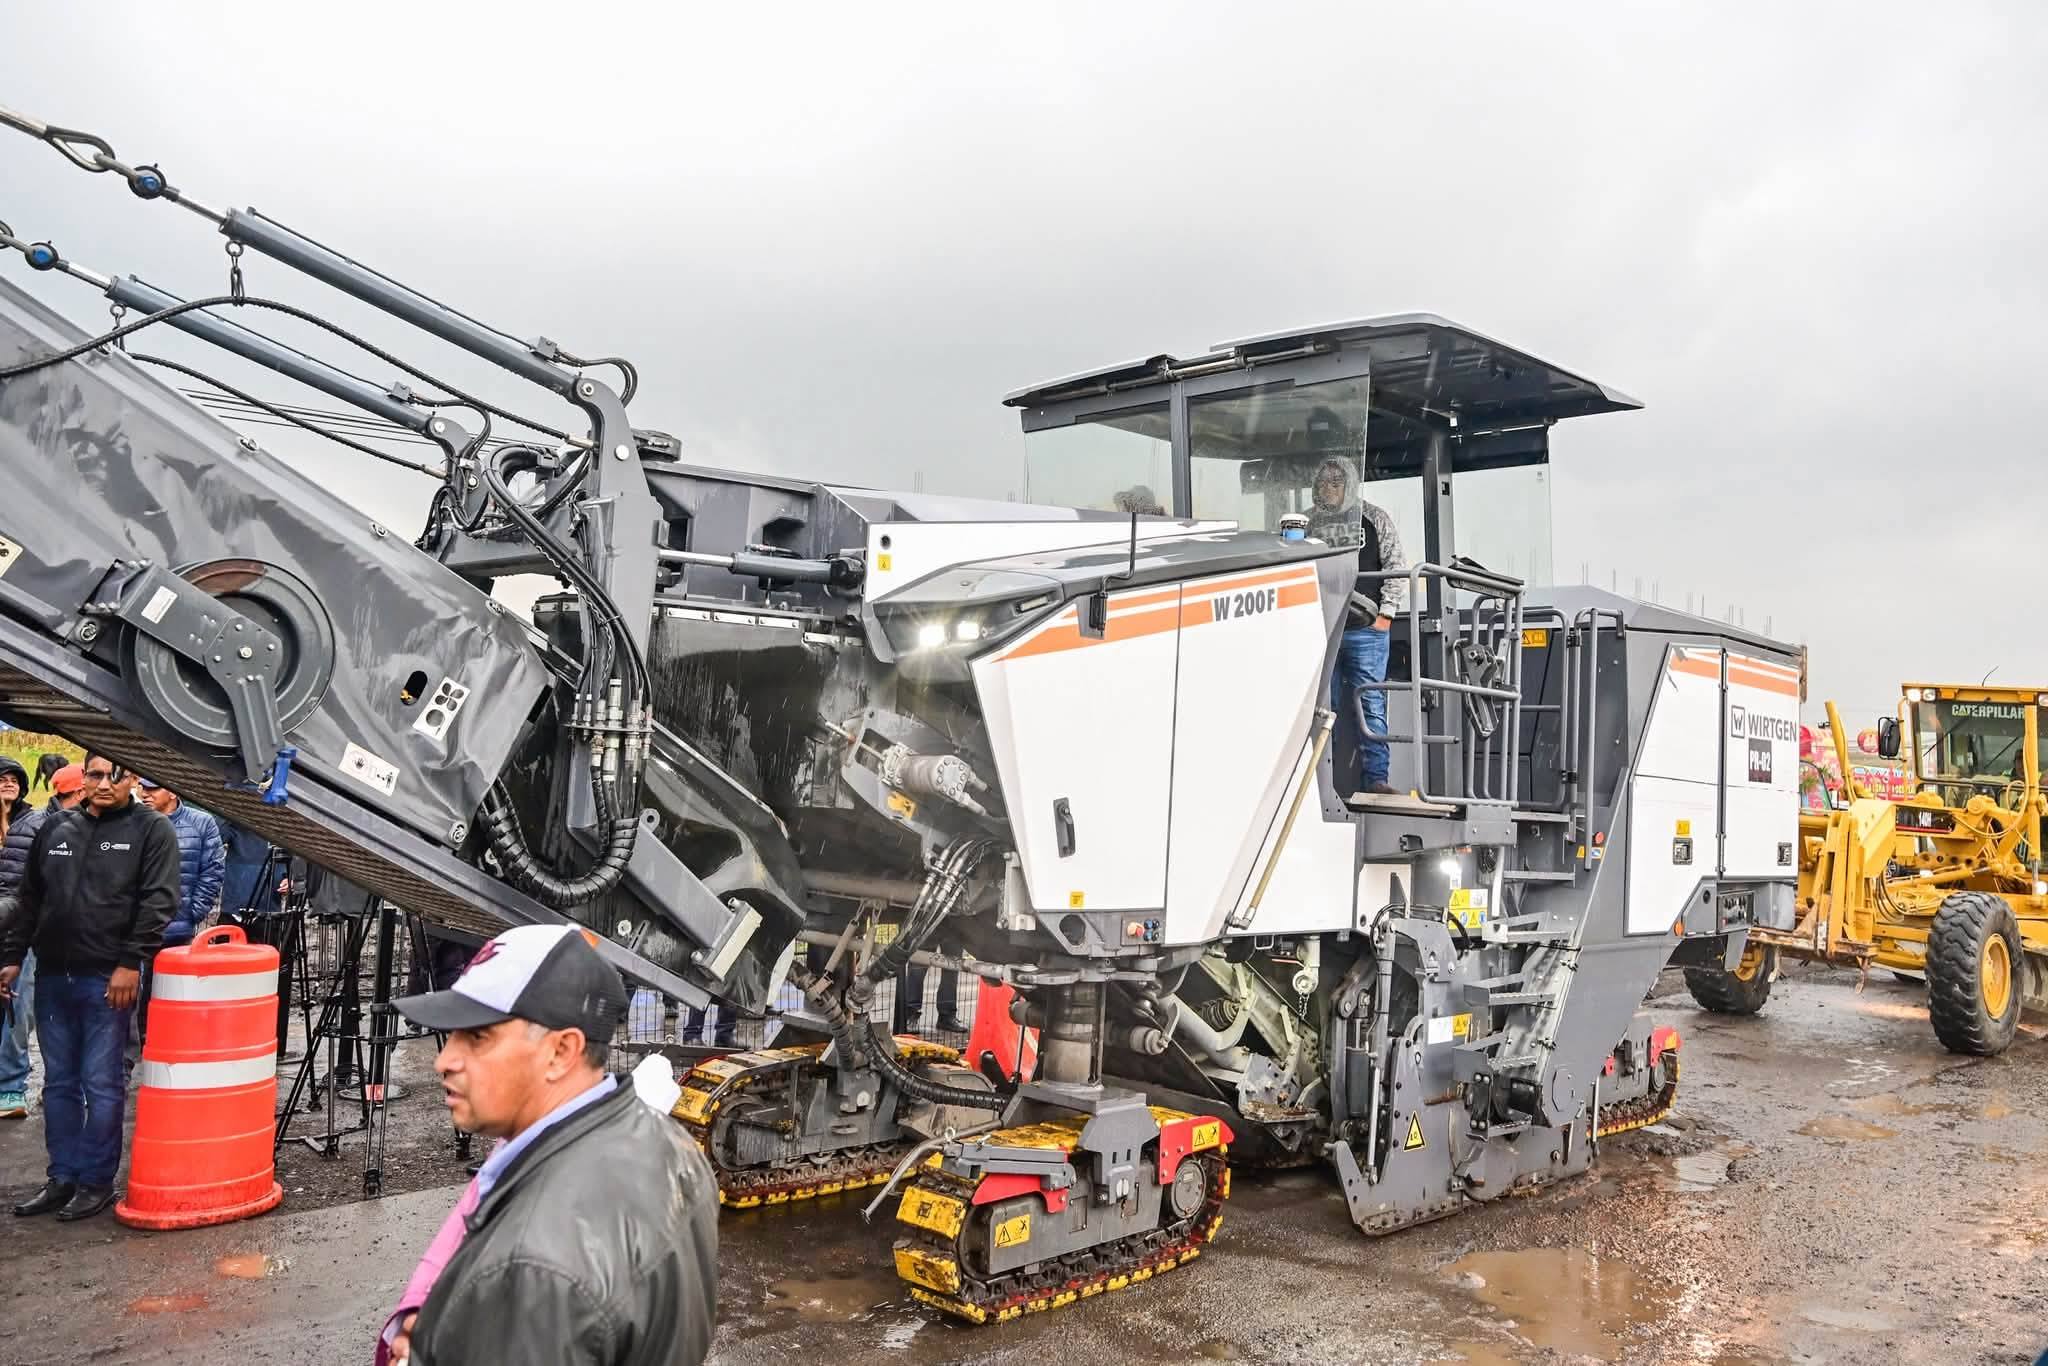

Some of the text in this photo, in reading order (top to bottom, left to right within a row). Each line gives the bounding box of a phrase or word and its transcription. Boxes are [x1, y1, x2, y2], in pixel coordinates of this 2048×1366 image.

[1214, 596, 1231, 622] W
[1952, 704, 2025, 720] CATERPILLAR
[1748, 713, 1797, 742] WIRTGEN
[1750, 750, 1771, 772] PR-02
